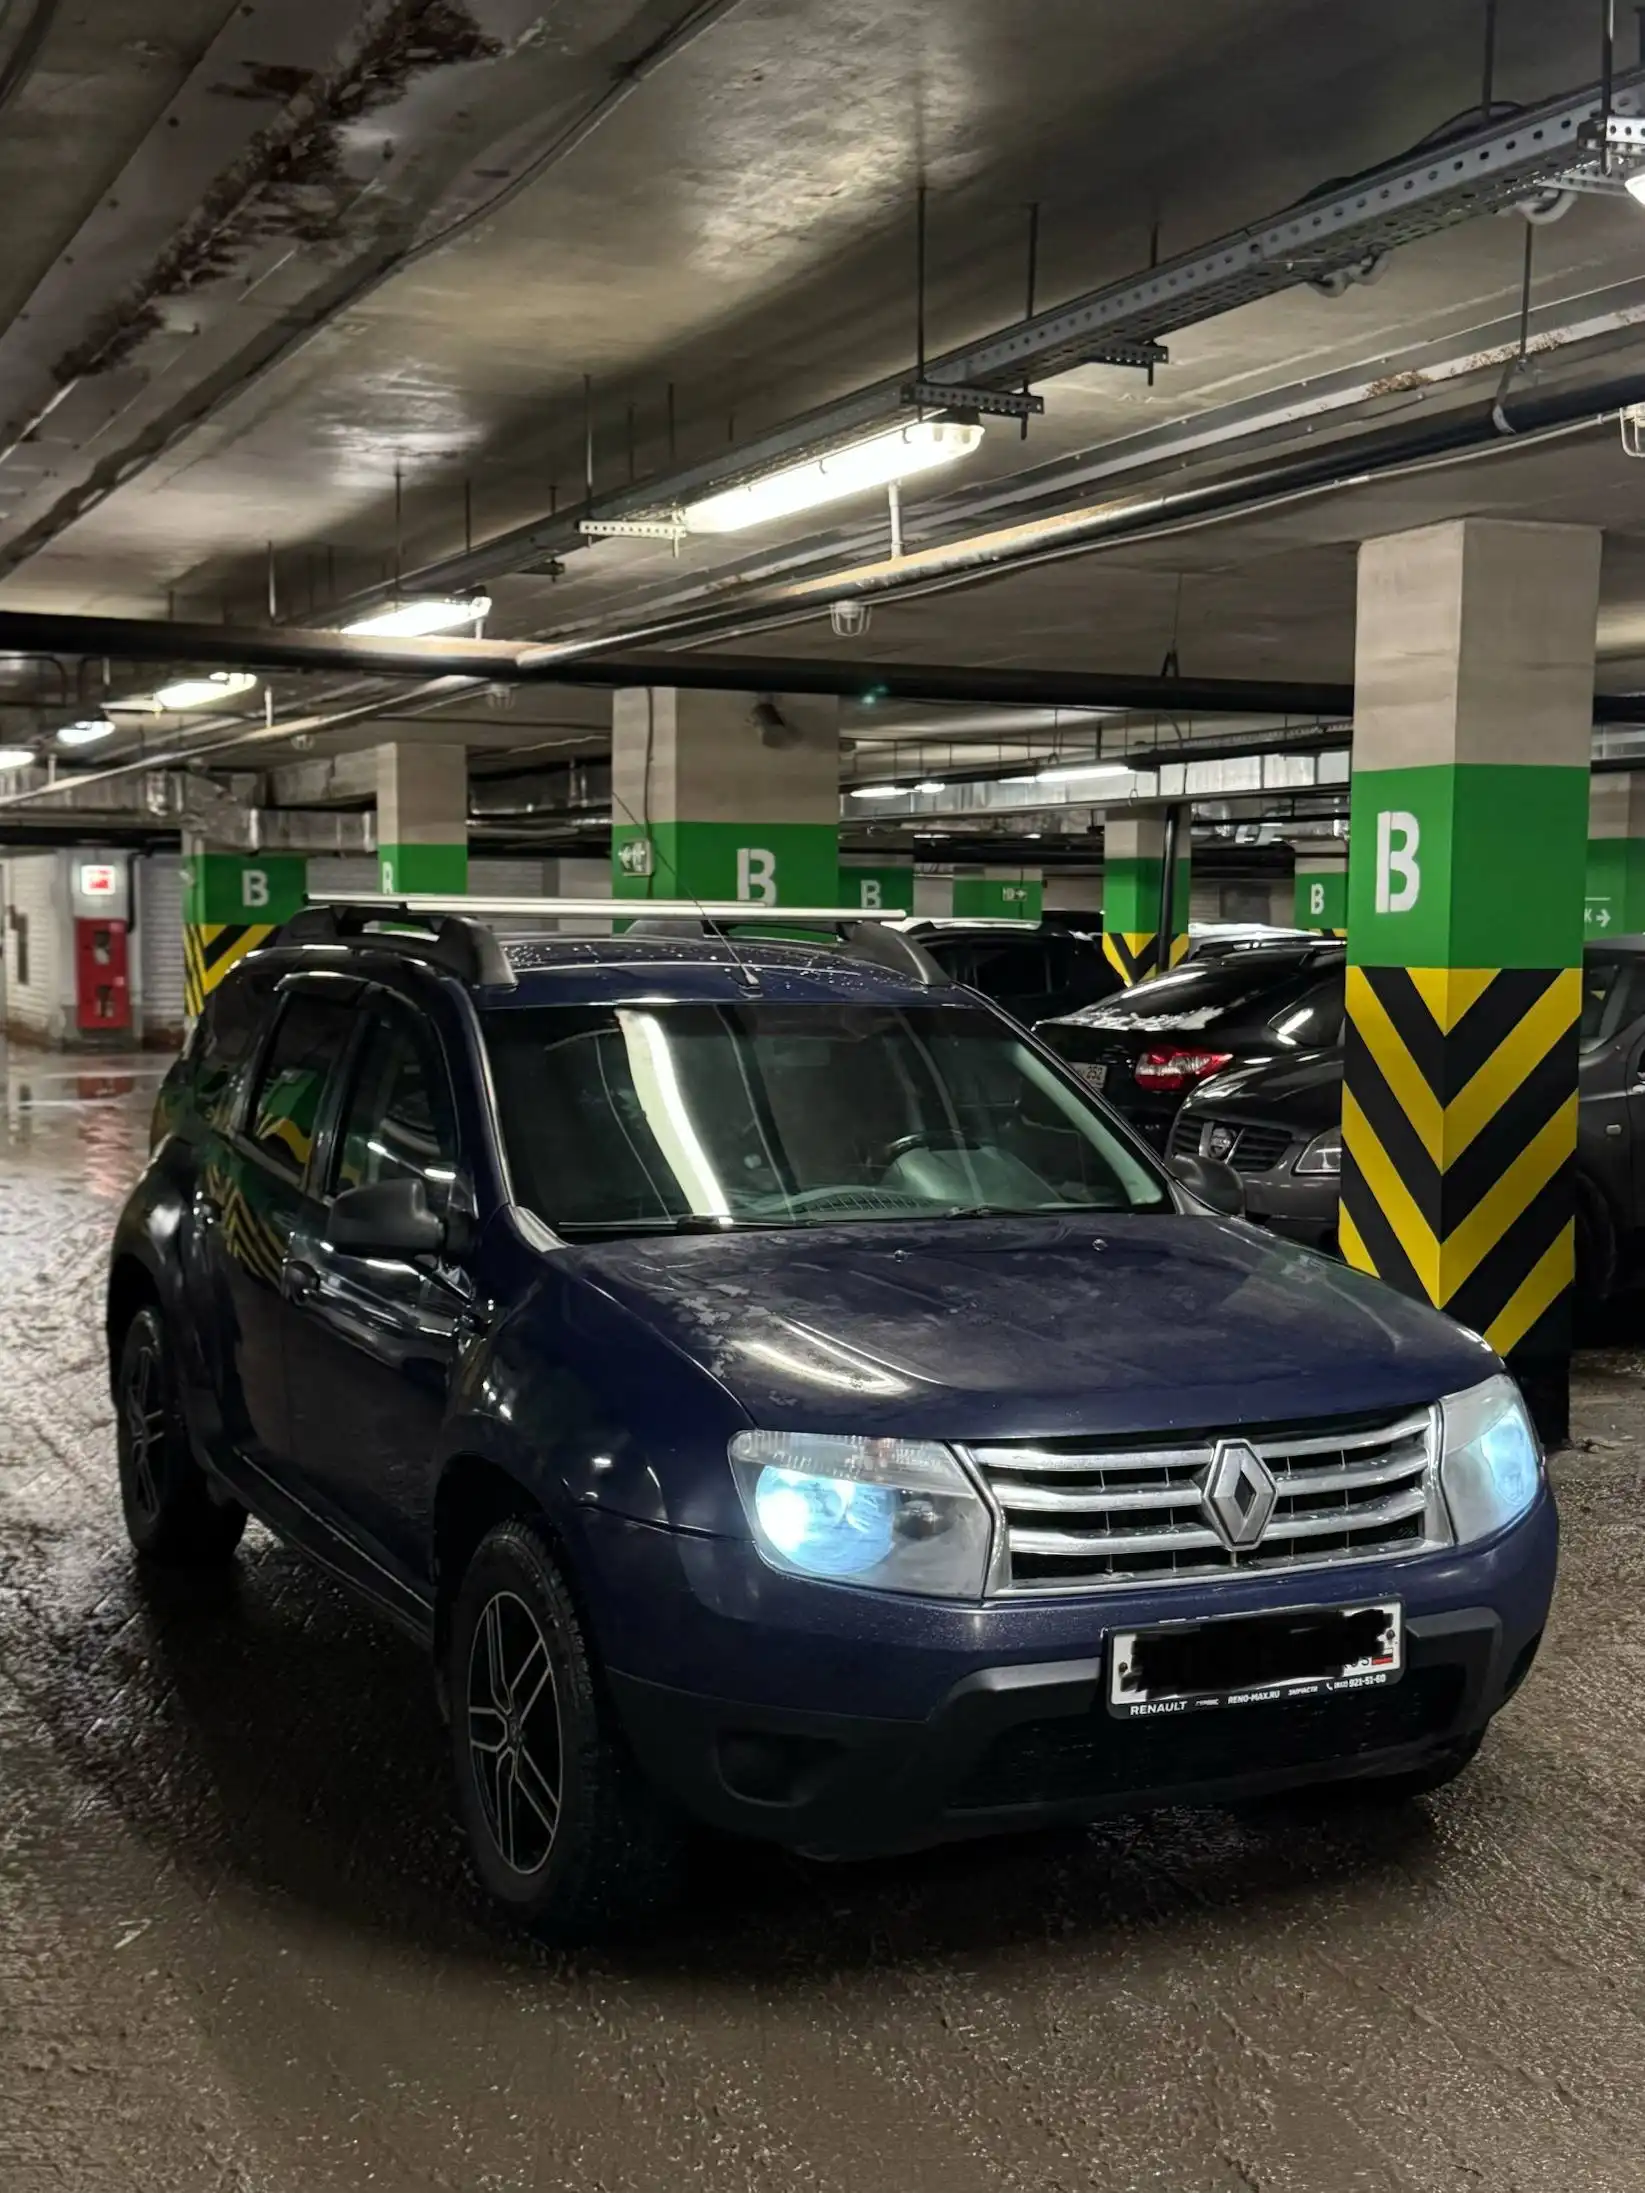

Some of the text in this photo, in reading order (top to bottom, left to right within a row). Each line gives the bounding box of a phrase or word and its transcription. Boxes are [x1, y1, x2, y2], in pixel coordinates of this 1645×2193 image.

[1375, 810, 1421, 914] B
[1129, 1701, 1188, 1716] RENAULT
[1227, 1690, 1280, 1704] RENO-MAX.RU
